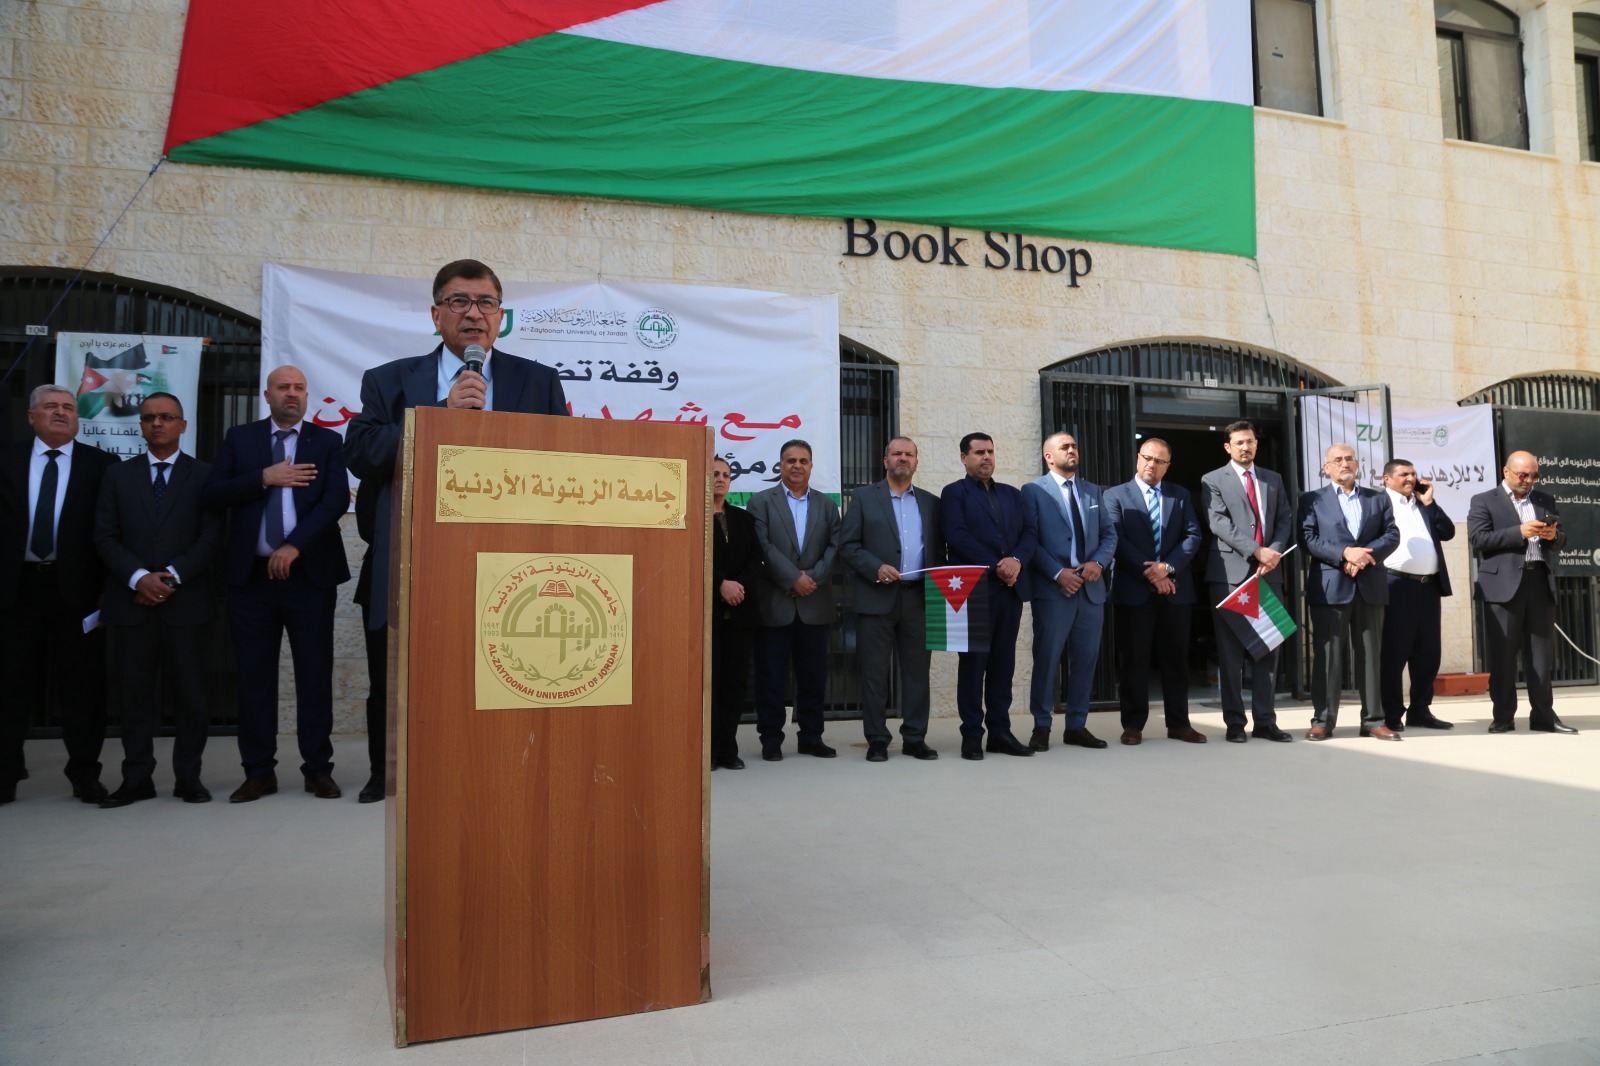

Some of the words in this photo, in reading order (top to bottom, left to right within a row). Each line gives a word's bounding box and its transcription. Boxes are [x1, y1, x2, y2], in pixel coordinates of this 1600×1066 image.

[842, 218, 969, 267] Book
[984, 231, 1092, 288] Shop
[520, 326, 565, 334] Al-Zaytoonah
[598, 360, 679, 391] وقفة
[110, 427, 140, 436] علمنا
[720, 412, 802, 441] مع
[1357, 424, 1383, 442] ZU
[444, 468, 526, 500] الأردنية
[1474, 464, 1485, 482] لا
[532, 473, 613, 506] الزيتونة
[617, 478, 676, 509] جامعة
[526, 561, 592, 580] الزيتونة
[1558, 558, 1575, 566] ARAB
[1575, 558, 1592, 566] BANK
[591, 574, 618, 617] جامعة
[488, 643, 535, 697] AL-ZAYTOONAH
[535, 684, 588, 700] UNIVERSITY
[587, 676, 599, 688] OF
[599, 643, 619, 680] JORDAN
